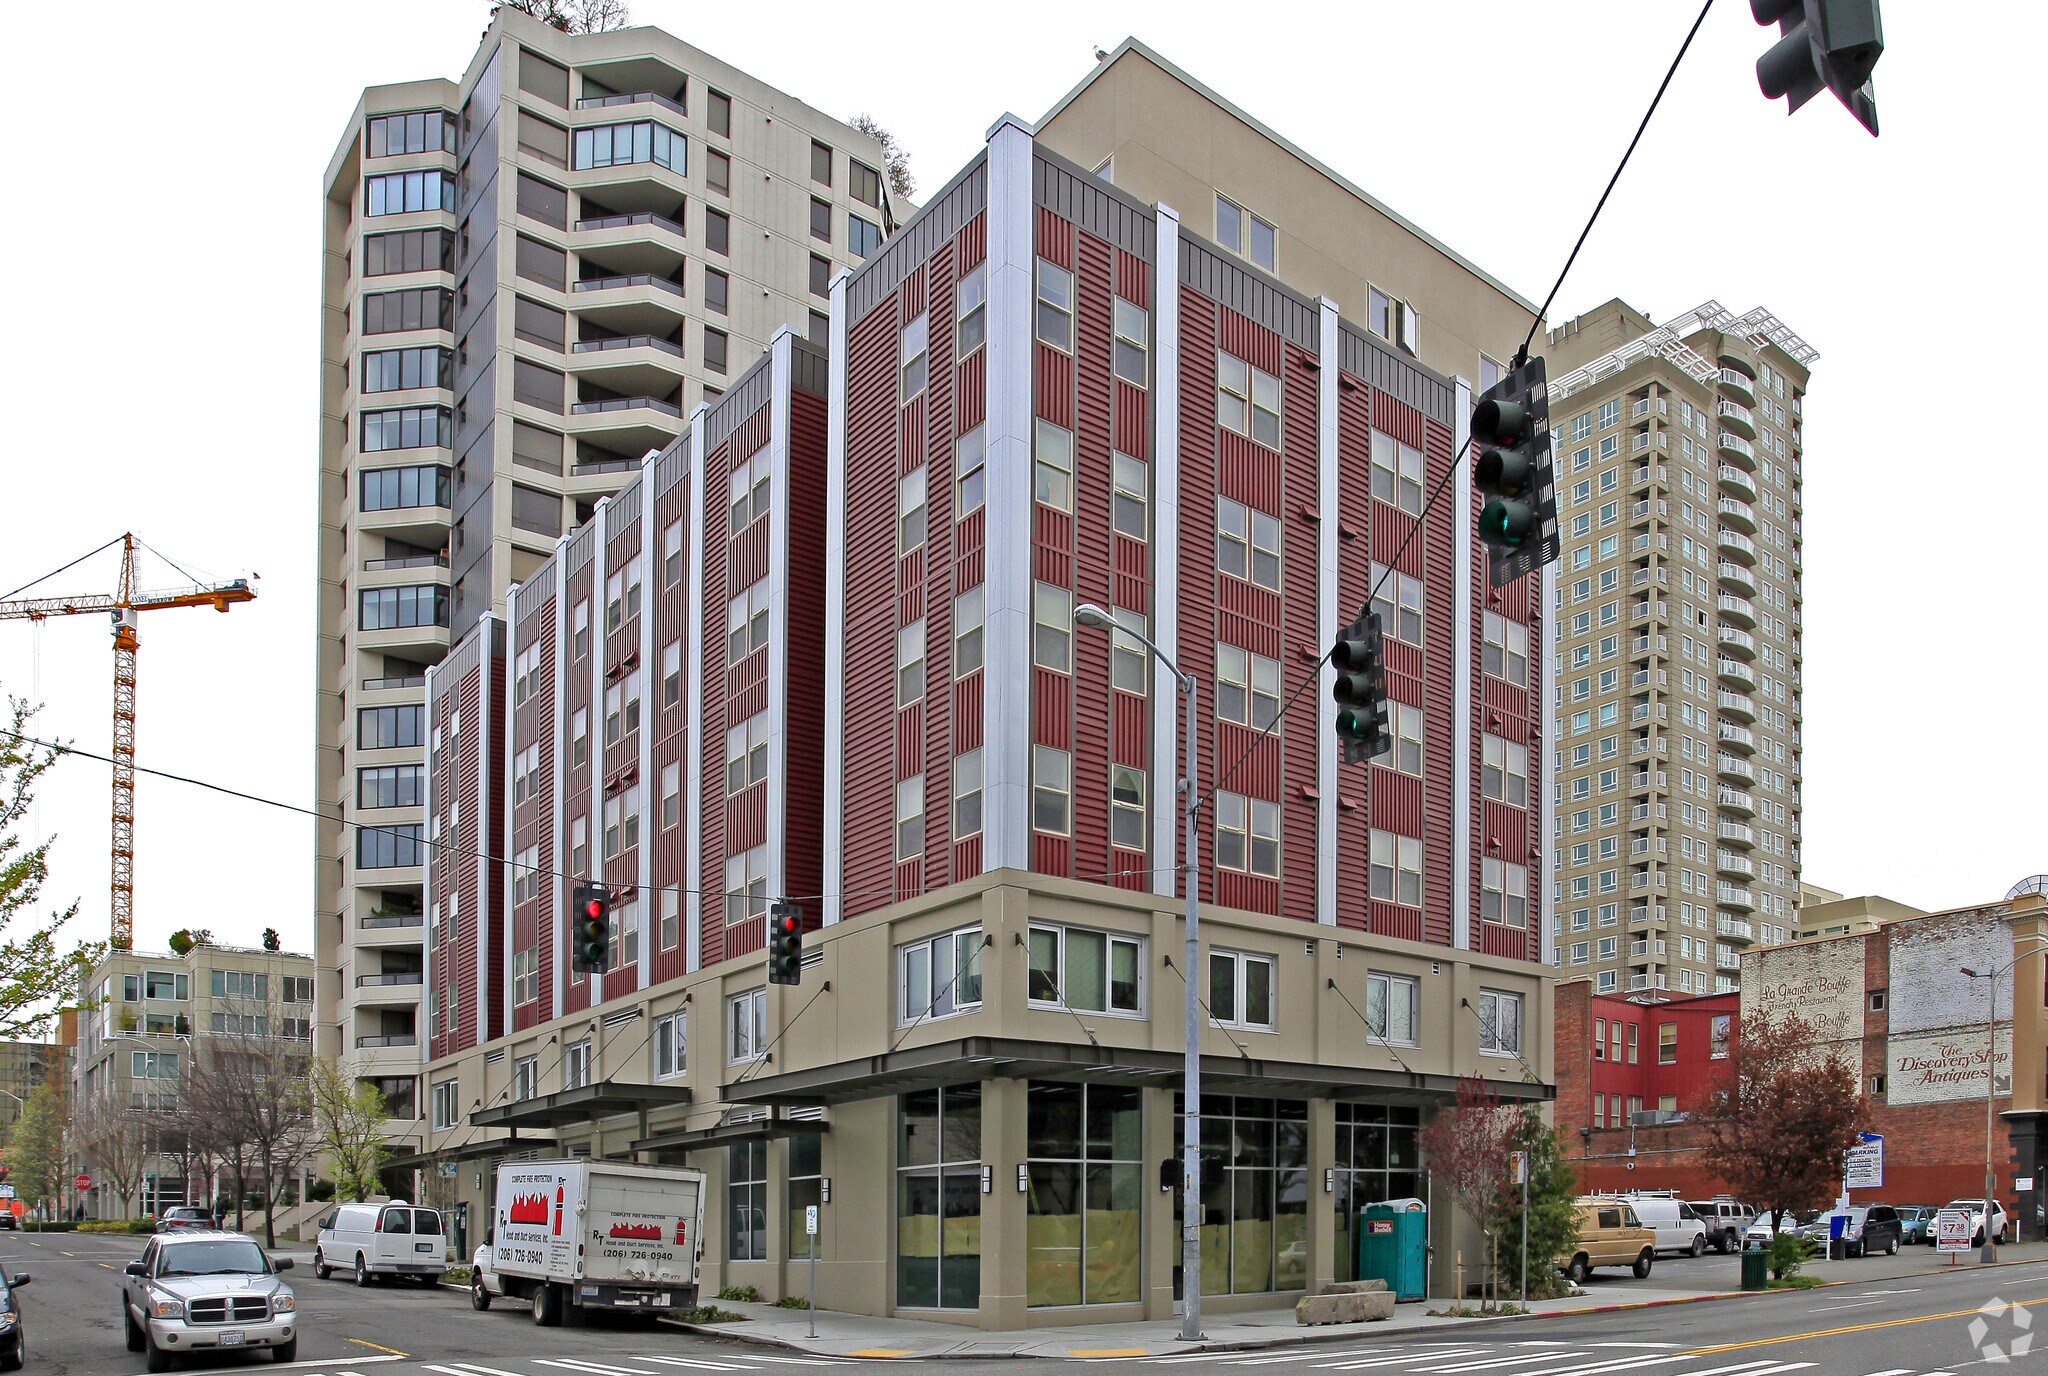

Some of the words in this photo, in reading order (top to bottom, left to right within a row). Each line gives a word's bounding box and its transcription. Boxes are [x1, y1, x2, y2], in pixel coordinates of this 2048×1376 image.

[1760, 986, 1775, 1001] La
[1778, 981, 1812, 1002] Grande
[1815, 976, 1851, 994] Bouffe
[1796, 994, 1838, 1007] Restaurant
[1813, 1011, 1850, 1028] Bouffe
[1940, 1042, 1962, 1058] The
[1897, 1055, 1973, 1072] Discovery
[1913, 1068, 1990, 1086] Antiques
[498, 1248, 512, 1261] (206)
[515, 1249, 543, 1264] 726-0940
[603, 1249, 626, 1258] (206)
[631, 1251, 673, 1260] 726-0940
